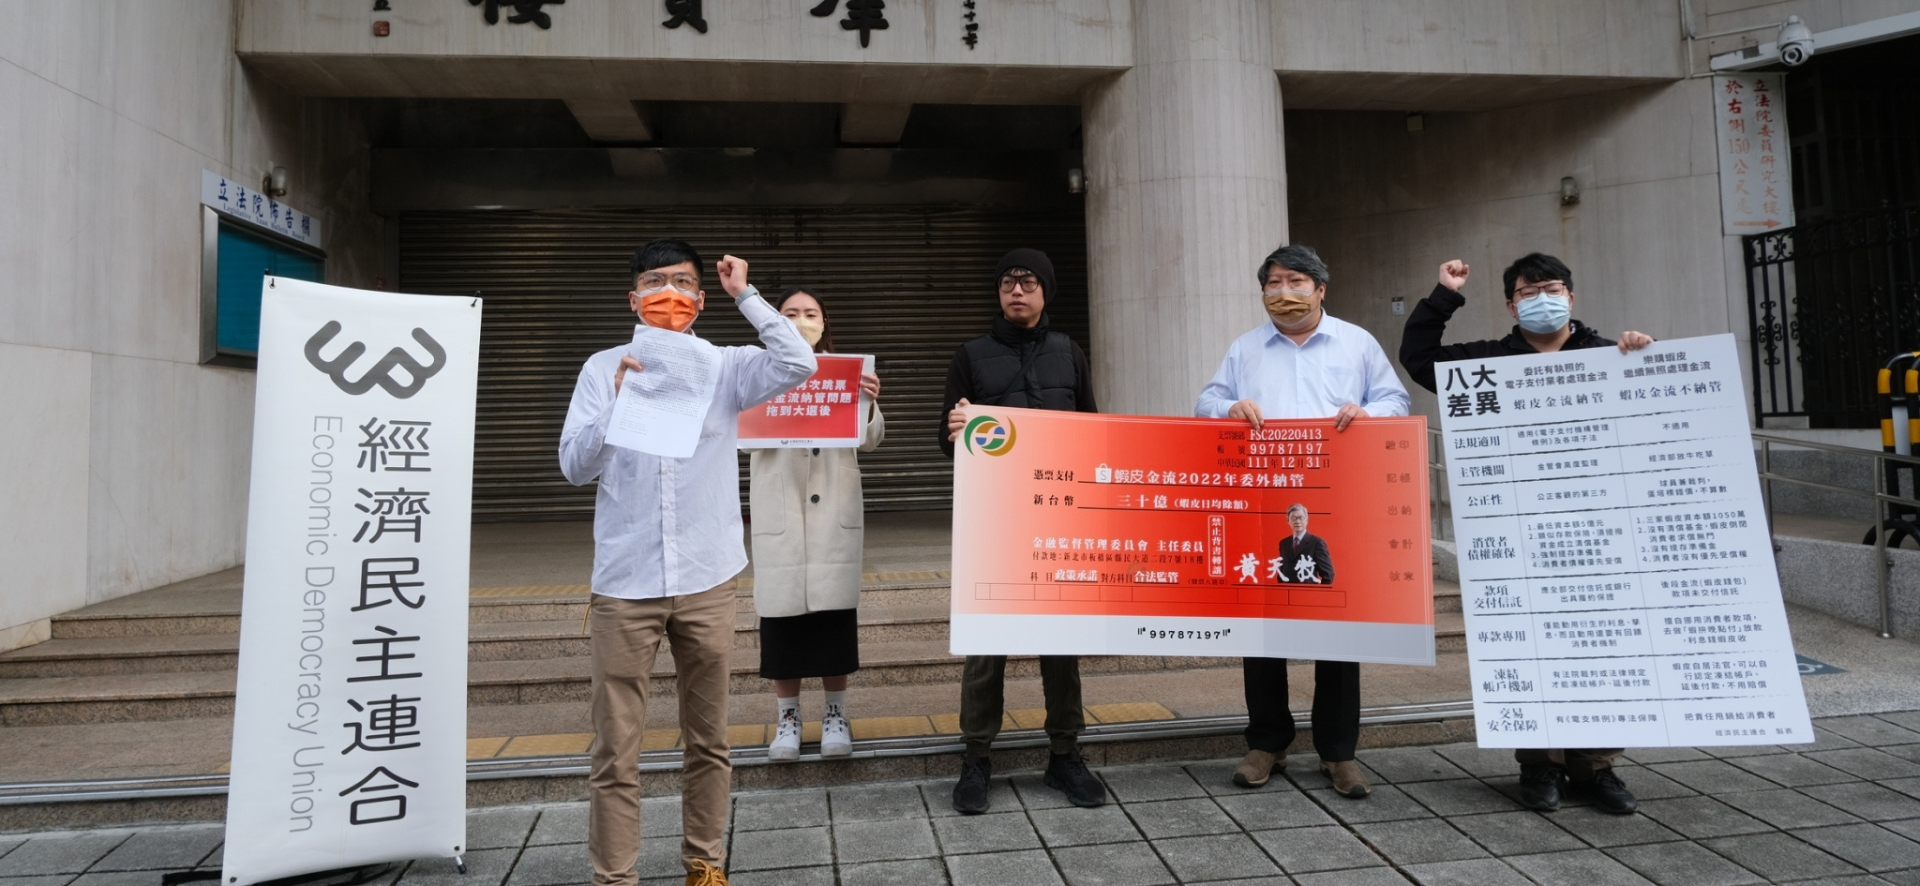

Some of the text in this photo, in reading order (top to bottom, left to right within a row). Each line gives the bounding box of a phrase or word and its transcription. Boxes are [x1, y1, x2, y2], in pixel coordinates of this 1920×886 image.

[223, 203, 305, 241] Legislative Yuan Bulletin Board
[1643, 351, 1687, 364] 樂購蝦皮
[1523, 362, 1585, 376] 委託有執照的
[1623, 361, 1711, 378] 繼續無照處理金流
[1445, 364, 1498, 391] 八大
[1505, 371, 1608, 389] 電子支付業者處理金流
[1620, 381, 1721, 400] 蝦皮金流不納管
[767, 392, 852, 403] 金流納管問題
[1447, 390, 1501, 418] 差異
[1514, 392, 1604, 410] 蝦皮金流納管
[766, 405, 831, 417] 拖到大選後
[1662, 422, 1689, 430] 不適用
[1250, 429, 1322, 440] FSC20220413
[1454, 435, 1500, 449] 法規適用
[1250, 443, 1323, 455] 99787197
[1649, 450, 1713, 462] 經濟部放牛吃草
[1460, 465, 1505, 478] 主管機關
[1538, 459, 1599, 471] 金管會高度監理
[1034, 469, 1074, 481] 憑票支付
[1115, 469, 1304, 487] 蝦皮金流2022年委外納管
[1117, 494, 1168, 509] 三十億
[1467, 494, 1503, 507] 公正性
[1537, 489, 1607, 501] 公正客觀的第三方
[1033, 537, 1204, 553] 金融監督管理委員會 主任委員
[1211, 517, 1222, 575] 禁止背書轉讓
[1472, 536, 1508, 549] 消費者
[1468, 547, 1516, 561] 債權確保
[1234, 553, 1321, 584] 黃天牧
[1054, 569, 1098, 581] 政策承諾
[1135, 571, 1179, 583] 合法監管
[1484, 585, 1509, 596] 款項
[1541, 582, 1631, 594] 應全部交付信託或銀行
[1672, 587, 1739, 598] 款項未交付信託
[1474, 596, 1522, 609] 交付信託
[287, 415, 343, 833] Economic Democracy Union
[339, 417, 432, 826] 經濟民主連合
[1150, 630, 1220, 640] 99787197
[1571, 639, 1617, 648] 消費者機制
[1494, 668, 1518, 680] 凍結
[1553, 668, 1646, 678] 有法院裁判或法律規定
[1483, 680, 1533, 693] 帳戶機制
[1500, 707, 1524, 720] 交易
[1684, 711, 1776, 722] 把責任甩鍋給消費者
[1488, 719, 1538, 732] 安全保障
[1715, 727, 1793, 737] 經濟民主連合 製表
